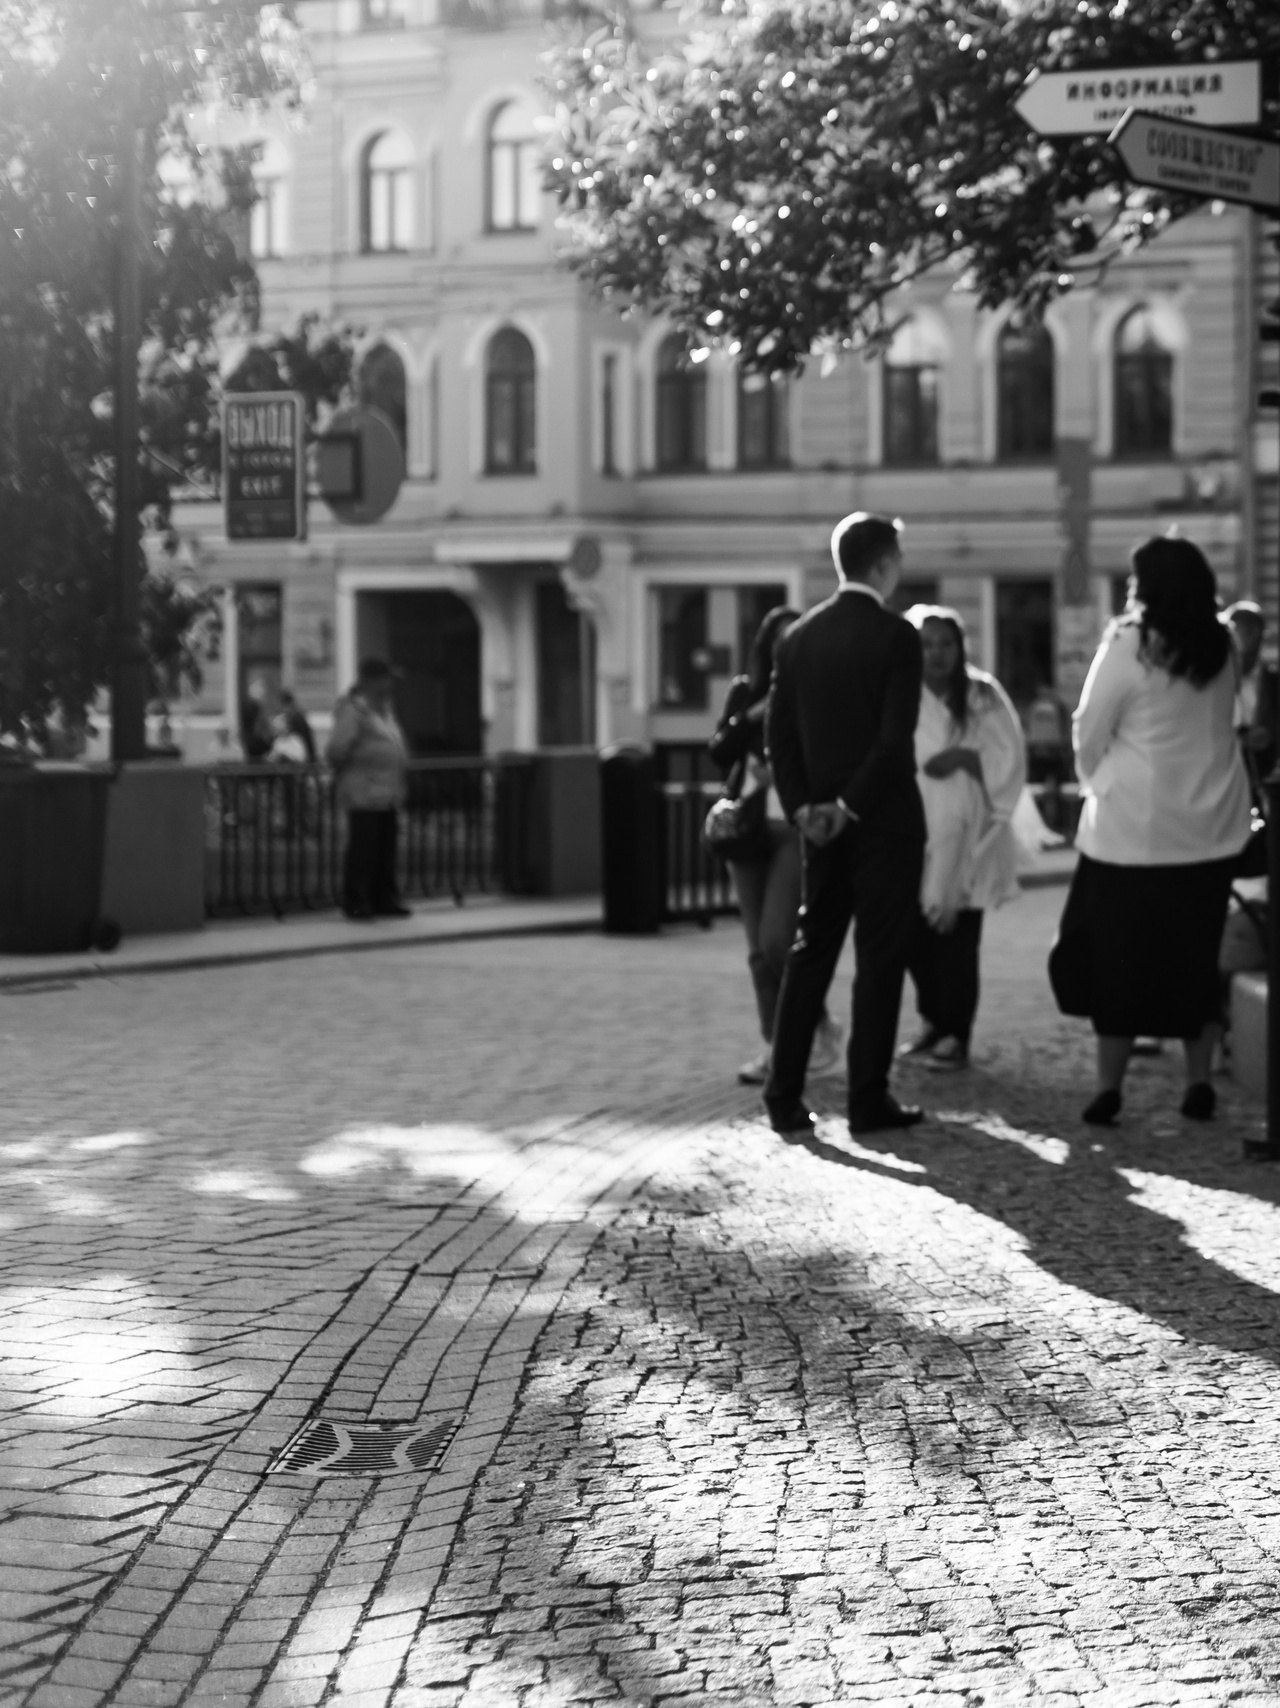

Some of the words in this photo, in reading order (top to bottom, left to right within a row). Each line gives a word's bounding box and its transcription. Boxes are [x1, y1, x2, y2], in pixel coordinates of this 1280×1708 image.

[1066, 73, 1222, 101] ИНФОРМАЦИЯ
[227, 403, 292, 448] ВЫХОД
[240, 475, 282, 498] EXIT
